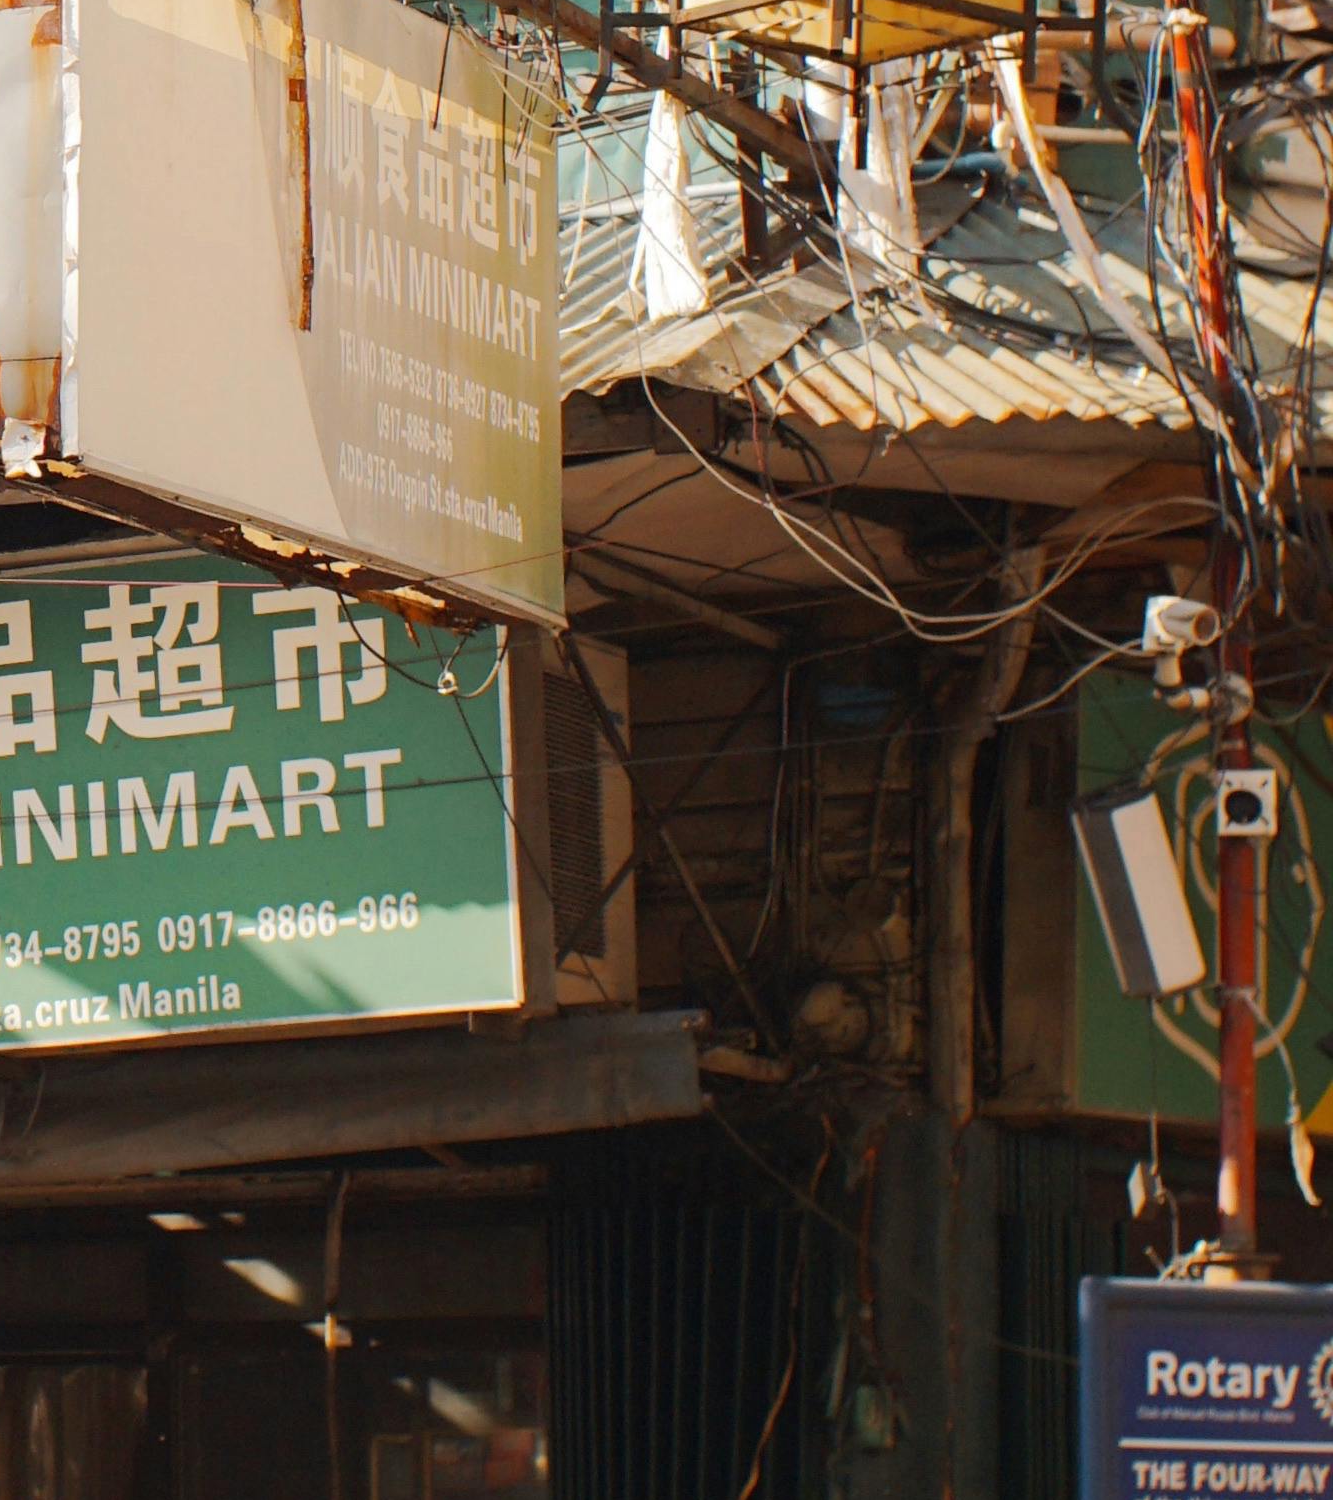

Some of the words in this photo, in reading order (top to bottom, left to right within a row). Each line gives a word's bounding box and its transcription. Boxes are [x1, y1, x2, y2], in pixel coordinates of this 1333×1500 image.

[310, 41, 541, 266] 顺食品超市
[408, 246, 542, 361] MINIMART
[339, 328, 359, 373] TEL
[389, 459, 429, 513] Ongpin
[487, 495, 523, 543] Manila
[156, 891, 420, 953] 0917-8866-966
[117, 974, 243, 1020] Manila
[1146, 1350, 1301, 1409] Rotary
[1132, 1460, 1187, 1491] THE
[1193, 1462, 1331, 1494] FOUR-WAY
